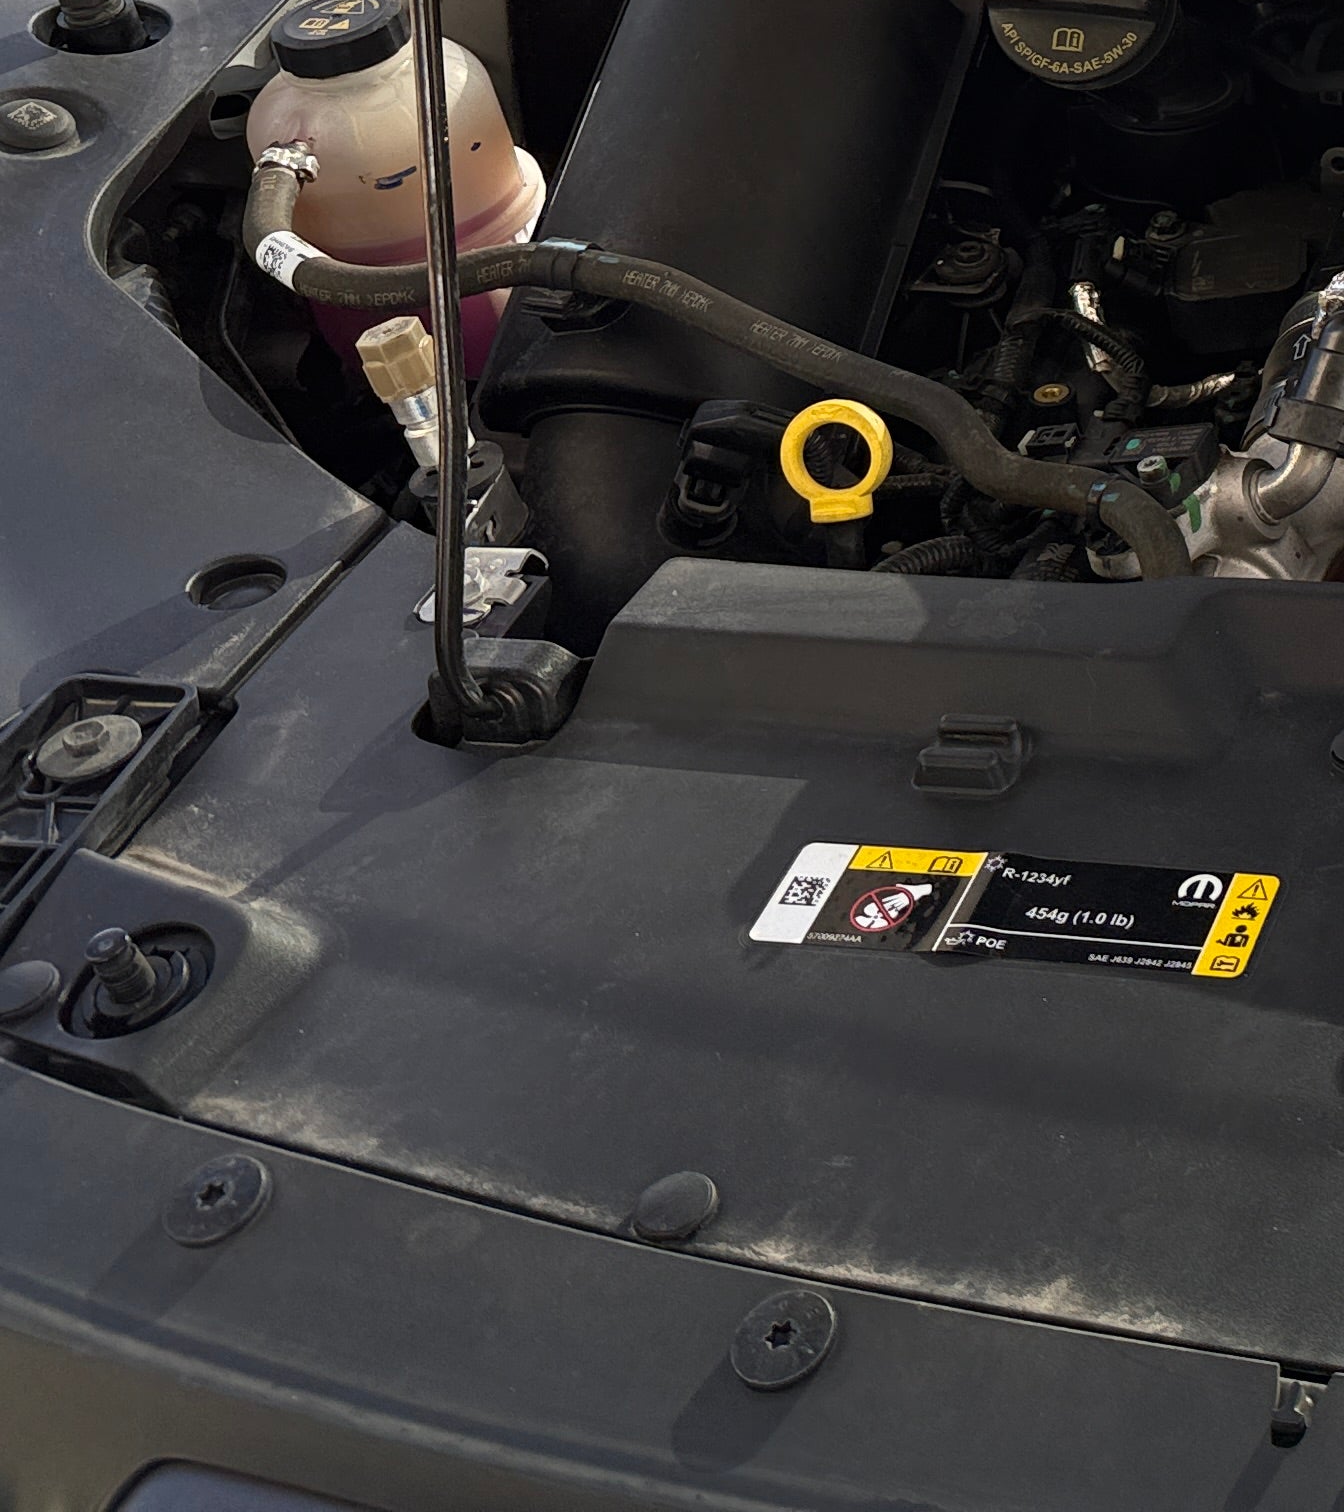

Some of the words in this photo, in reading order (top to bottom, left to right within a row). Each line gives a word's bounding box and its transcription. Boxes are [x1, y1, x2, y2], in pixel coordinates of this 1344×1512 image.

[1001, 22, 1020, 45] API
[1015, 31, 1138, 74] SP/GF-6A-SAE-5W-30
[476, 260, 514, 284] HEATER
[622, 269, 661, 290] HEATER
[749, 319, 788, 341] HEATER
[1001, 866, 1072, 888] R-1234yf
[1171, 899, 1216, 910] MOPAR
[1025, 906, 1069, 925] 454g
[1072, 909, 1106, 926] (1.0
[1109, 911, 1135, 931] lb)
[975, 936, 1007, 951] POE
[1087, 953, 1110, 963] SAE
